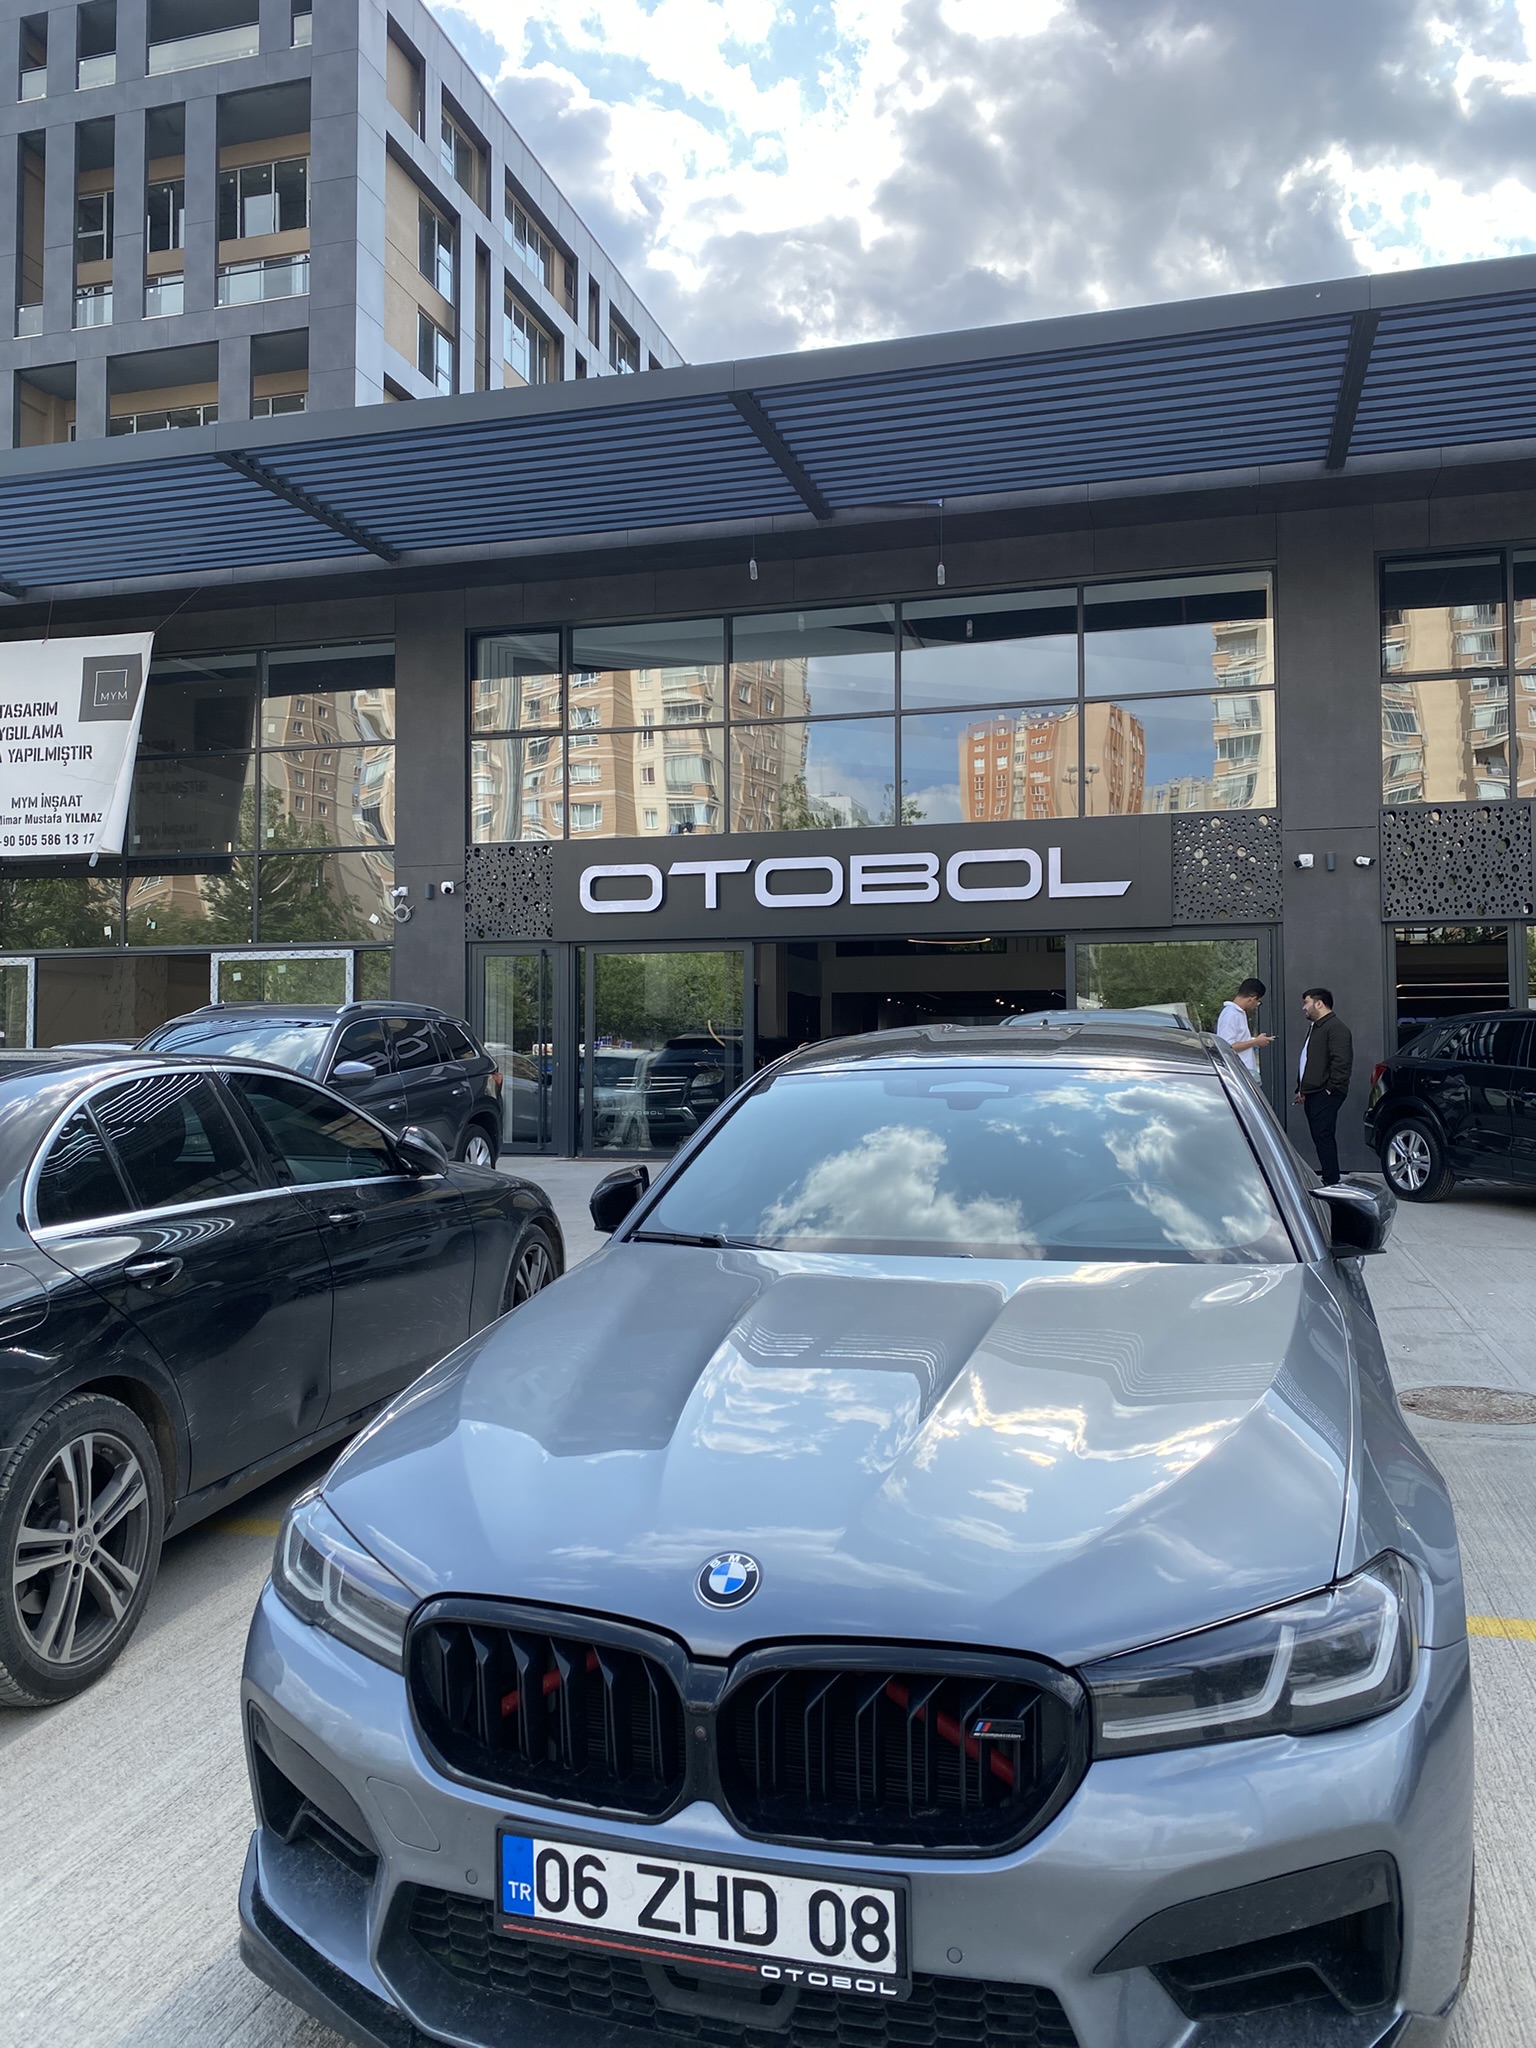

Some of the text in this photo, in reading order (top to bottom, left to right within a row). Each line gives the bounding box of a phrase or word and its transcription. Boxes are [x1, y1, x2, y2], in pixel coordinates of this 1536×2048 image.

[100, 690, 128, 702] MYM
[0, 701, 58, 718] TASARIM
[8, 745, 93, 767] YAPILMIŞTIR
[11, 792, 83, 812] MYM İNŞAAT
[0, 812, 102, 825] imar Mustafa YILMAZ
[18, 834, 38, 847] 505
[41, 833, 61, 846] 586
[65, 833, 79, 845] 13
[83, 833, 95, 845] 17
[579, 846, 1133, 914] OTOBOL
[709, 1553, 757, 1572] BMW
[507, 1880, 532, 1901] TR
[535, 1847, 890, 1963] 06 ZHD 08
[760, 1964, 898, 1996] OTOBOL
